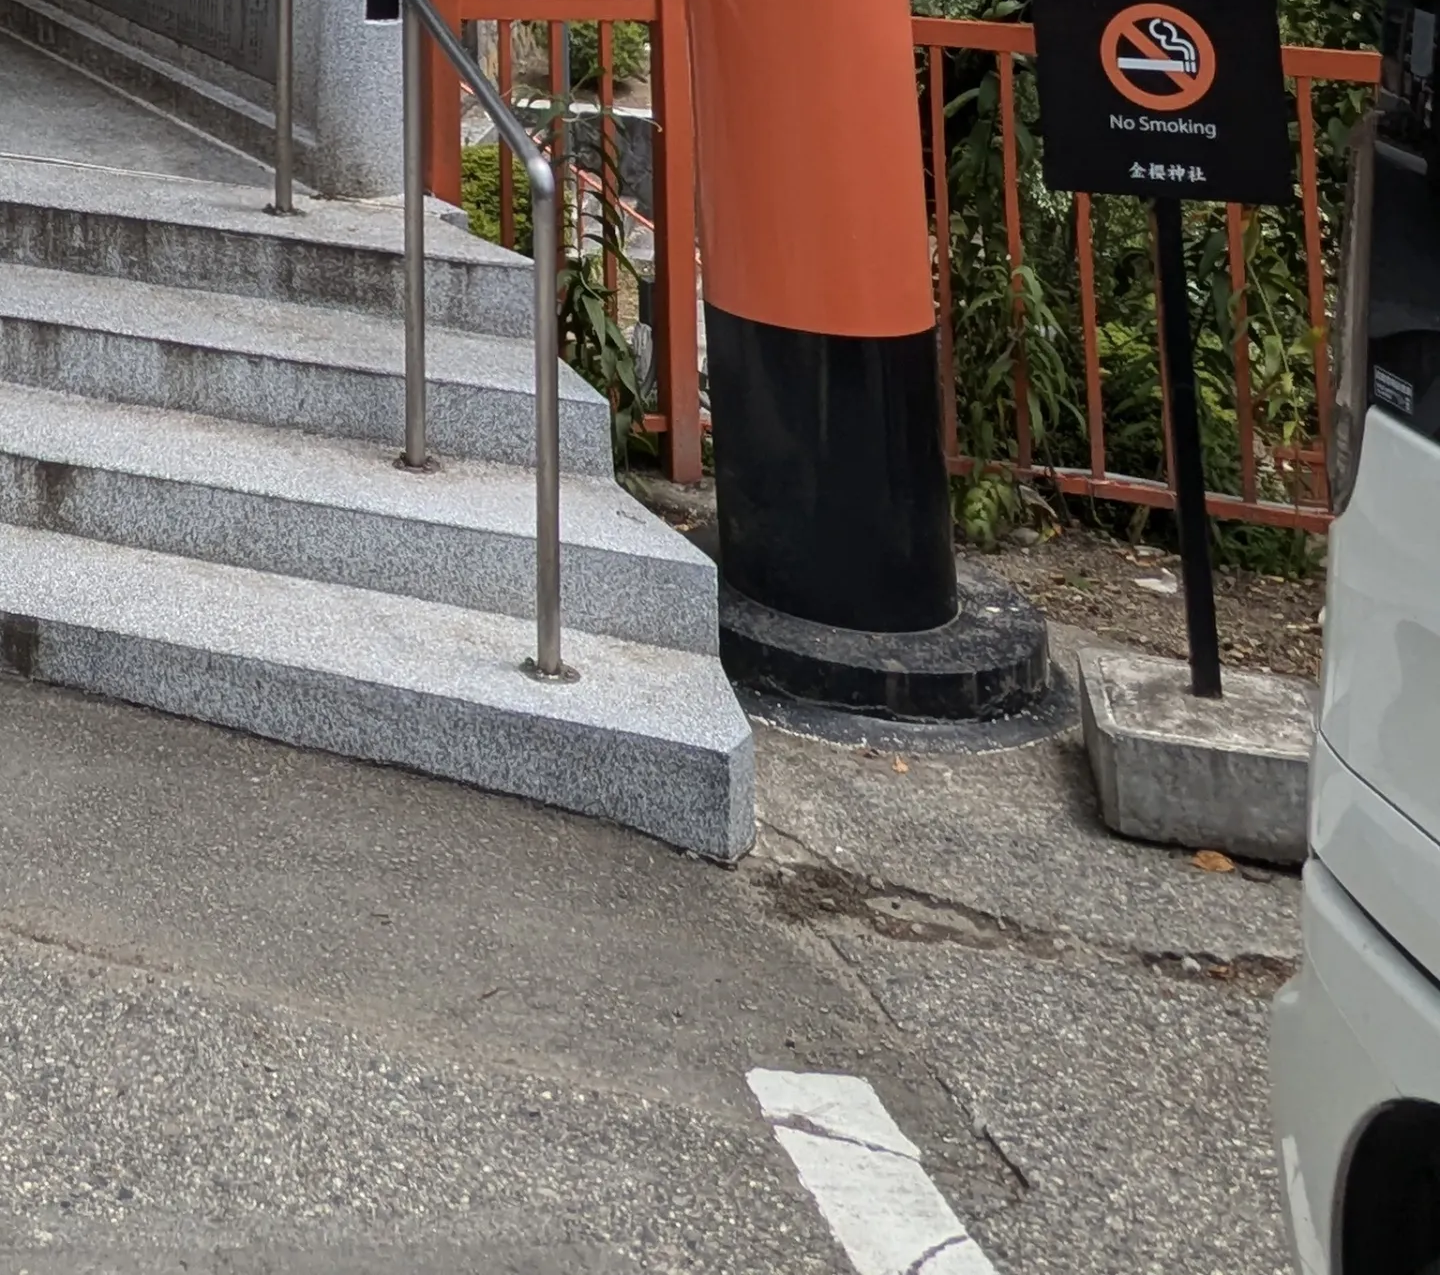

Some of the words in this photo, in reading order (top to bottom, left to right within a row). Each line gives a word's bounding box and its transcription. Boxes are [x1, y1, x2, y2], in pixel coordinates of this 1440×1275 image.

[1109, 114, 1135, 131] No
[1139, 116, 1217, 139] Smoking
[1128, 162, 1207, 182] 金櫻神社
